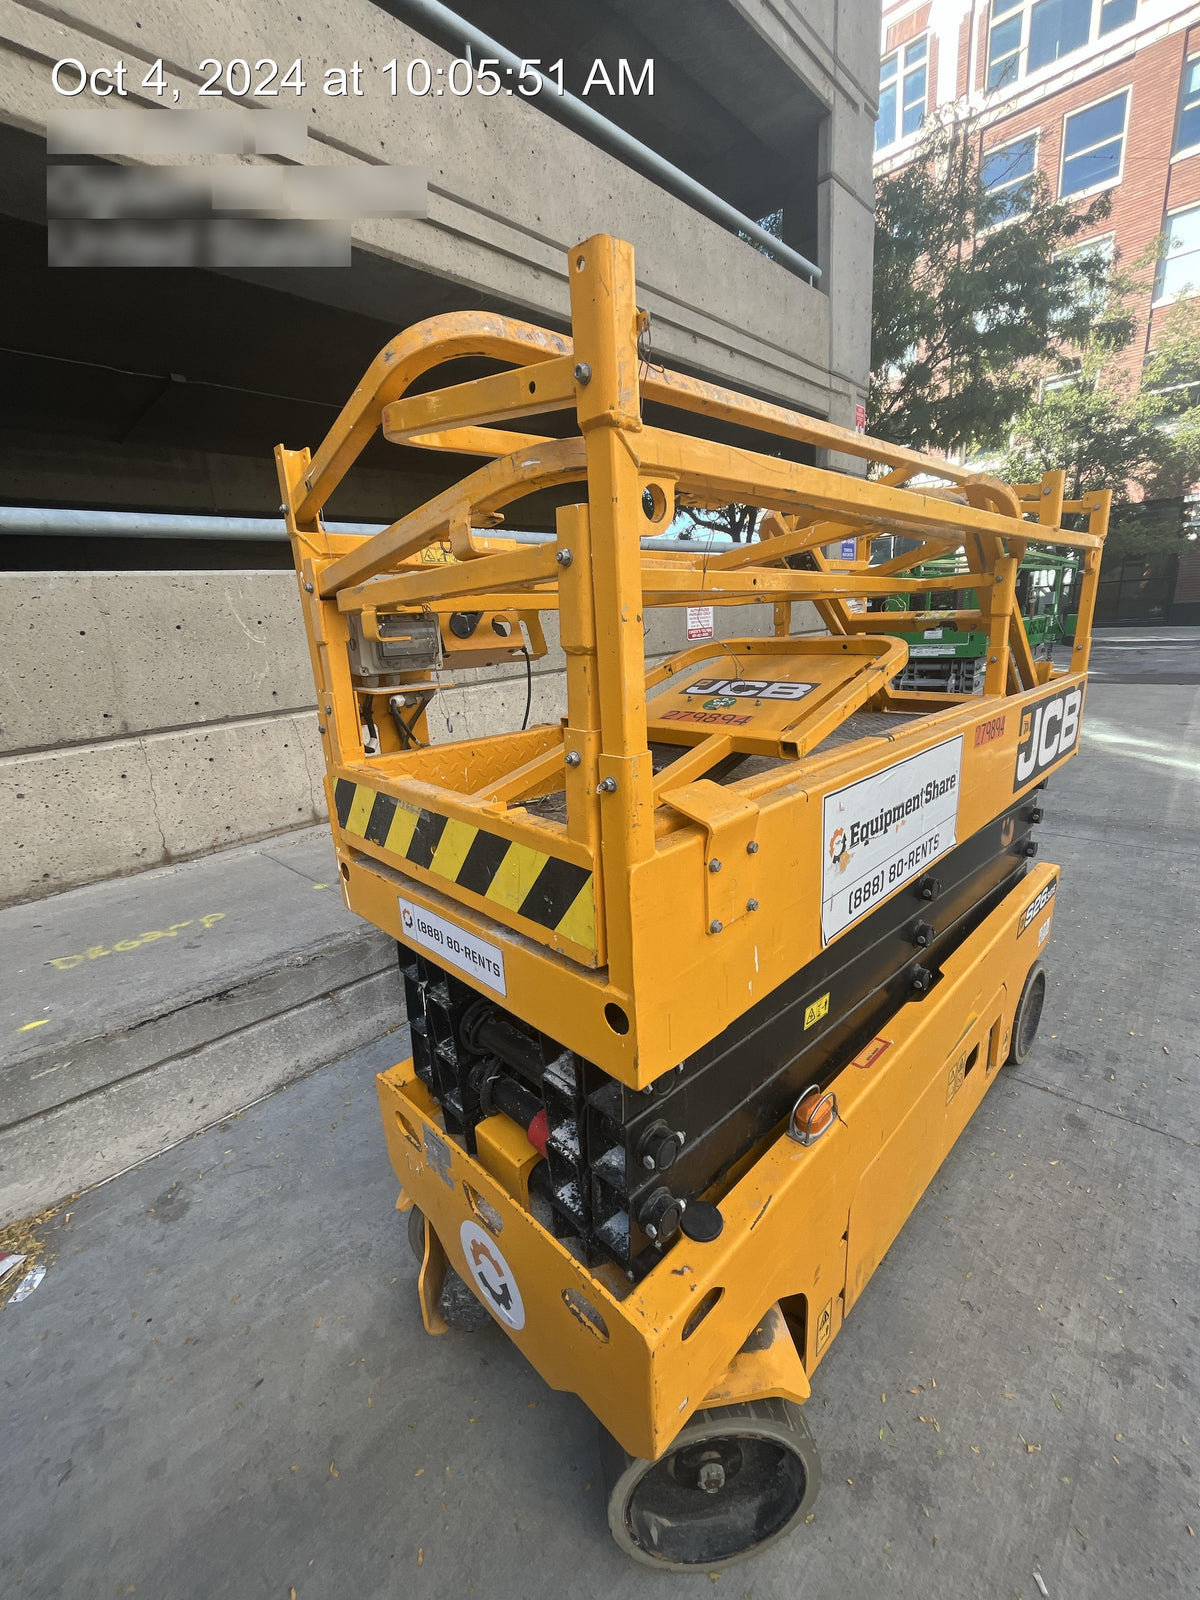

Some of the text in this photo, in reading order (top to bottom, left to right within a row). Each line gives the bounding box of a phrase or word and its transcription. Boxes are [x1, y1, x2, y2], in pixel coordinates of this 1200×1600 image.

[659, 710, 753, 726] 279894
[686, 679, 814, 700] JCB
[976, 715, 1006, 746] 279894
[1017, 689, 1082, 782] JCB
[850, 773, 957, 847] EquipmentShare
[848, 833, 941, 914] (888) 80-RENTS
[416, 918, 501, 978] (888) 80-RENTS
